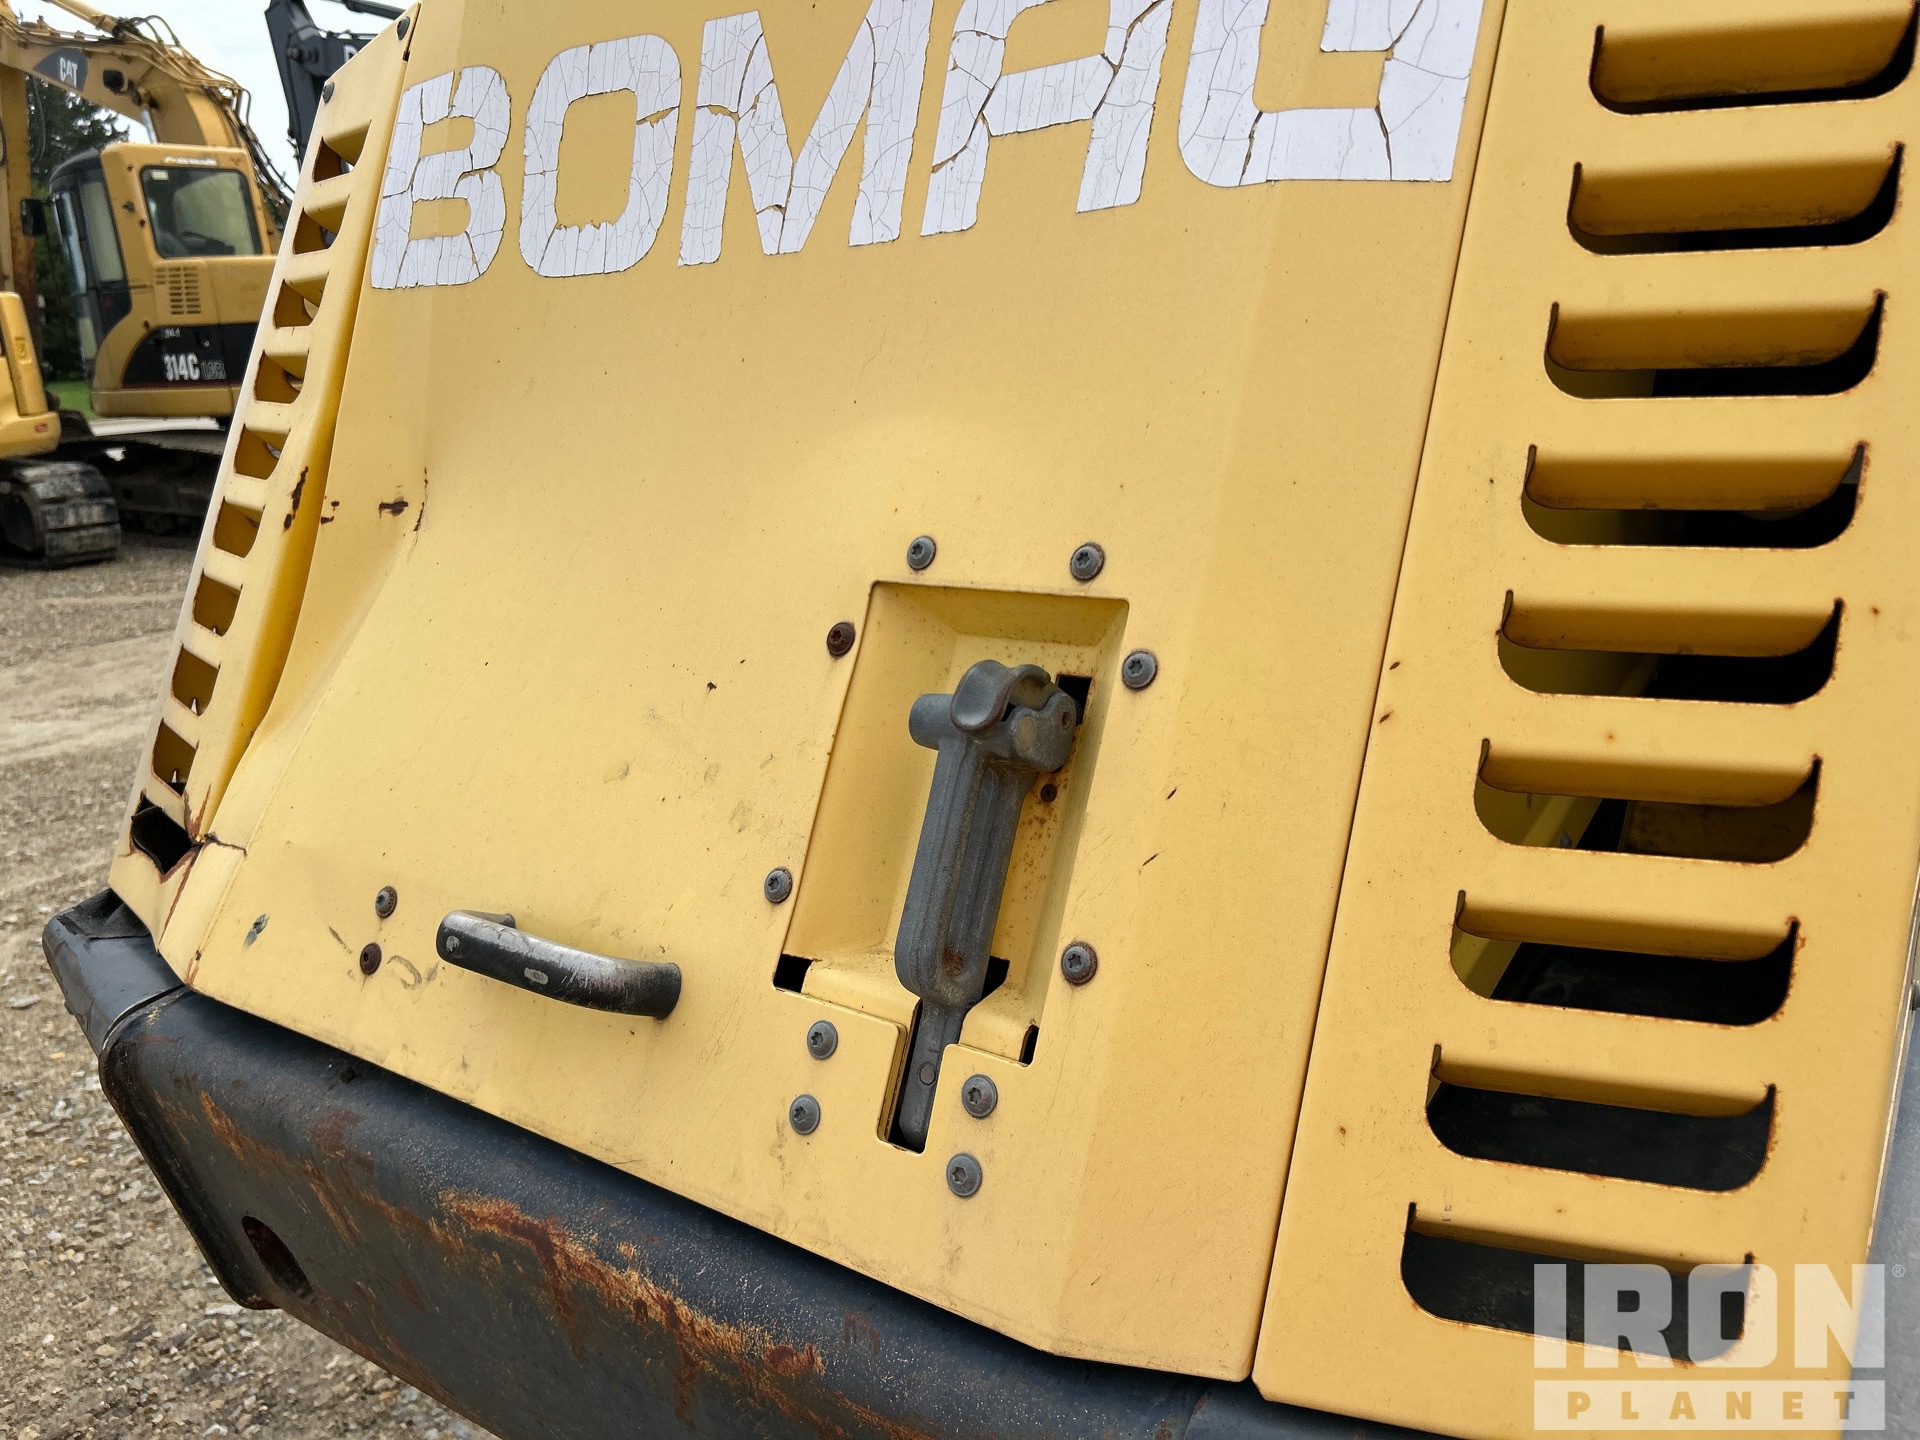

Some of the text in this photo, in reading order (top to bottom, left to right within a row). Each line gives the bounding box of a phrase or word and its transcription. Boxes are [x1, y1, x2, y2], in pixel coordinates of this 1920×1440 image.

[60, 57, 78, 88] CAT
[371, 0, 1484, 290] BOMAG
[164, 353, 200, 381] 314C
